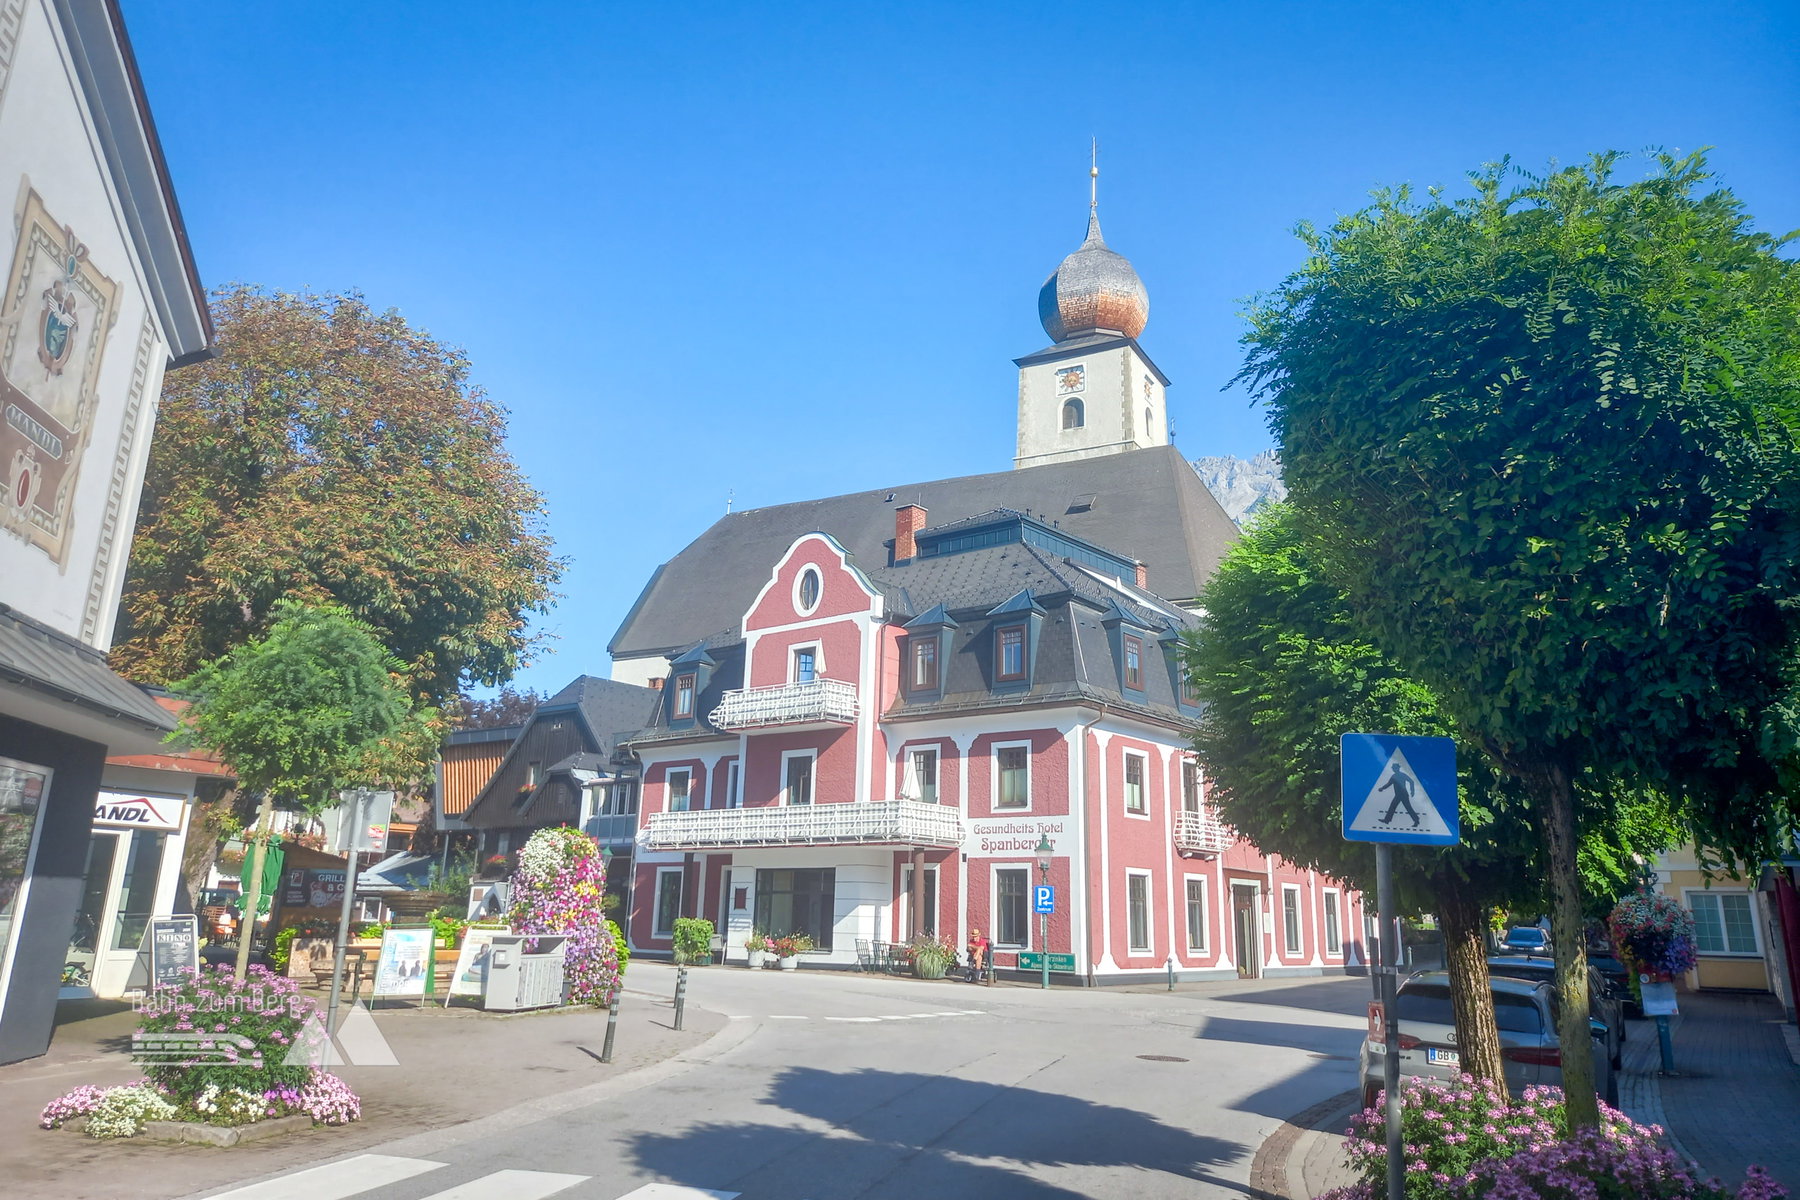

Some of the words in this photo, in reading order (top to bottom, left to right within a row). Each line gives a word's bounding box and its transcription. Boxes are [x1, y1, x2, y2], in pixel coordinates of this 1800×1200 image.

[973, 823, 1034, 835] Gesundheits
[1037, 822, 1063, 834] Hotel
[981, 837, 1056, 854] Spanbergr
[1037, 887, 1050, 906] P
[157, 934, 191, 942] KINO
